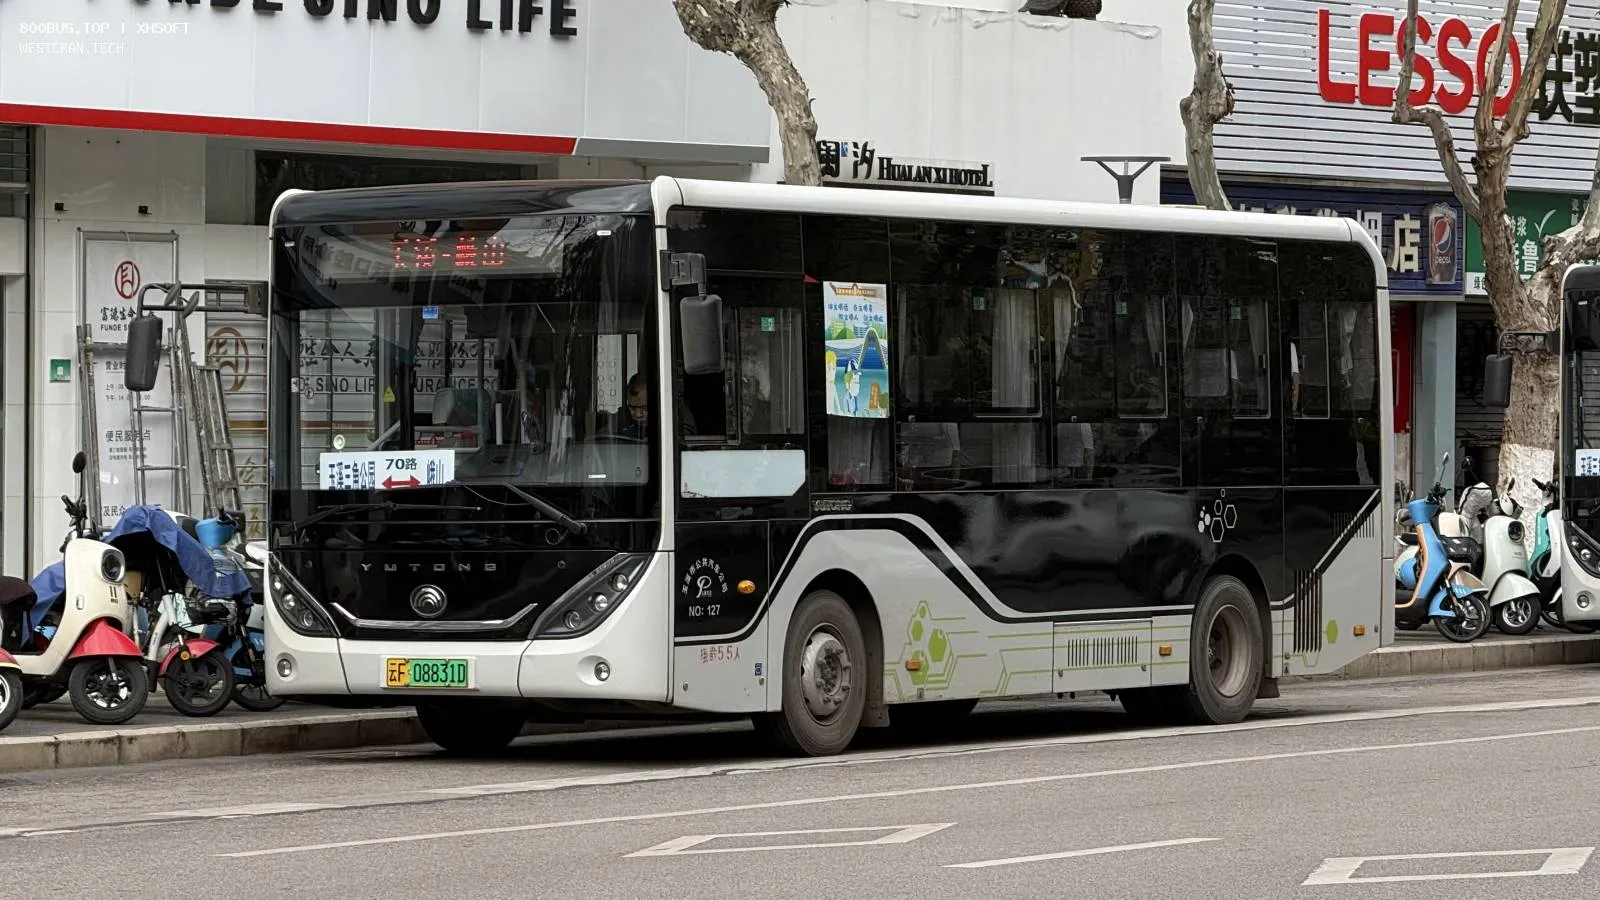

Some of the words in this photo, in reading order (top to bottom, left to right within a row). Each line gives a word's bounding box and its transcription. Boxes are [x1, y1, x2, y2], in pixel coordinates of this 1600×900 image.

[1317, 9, 1522, 117] LESSO
[385, 458, 417, 471] 70路
[360, 563, 497, 572] YUTONG
[707, 604, 721, 616] 127
